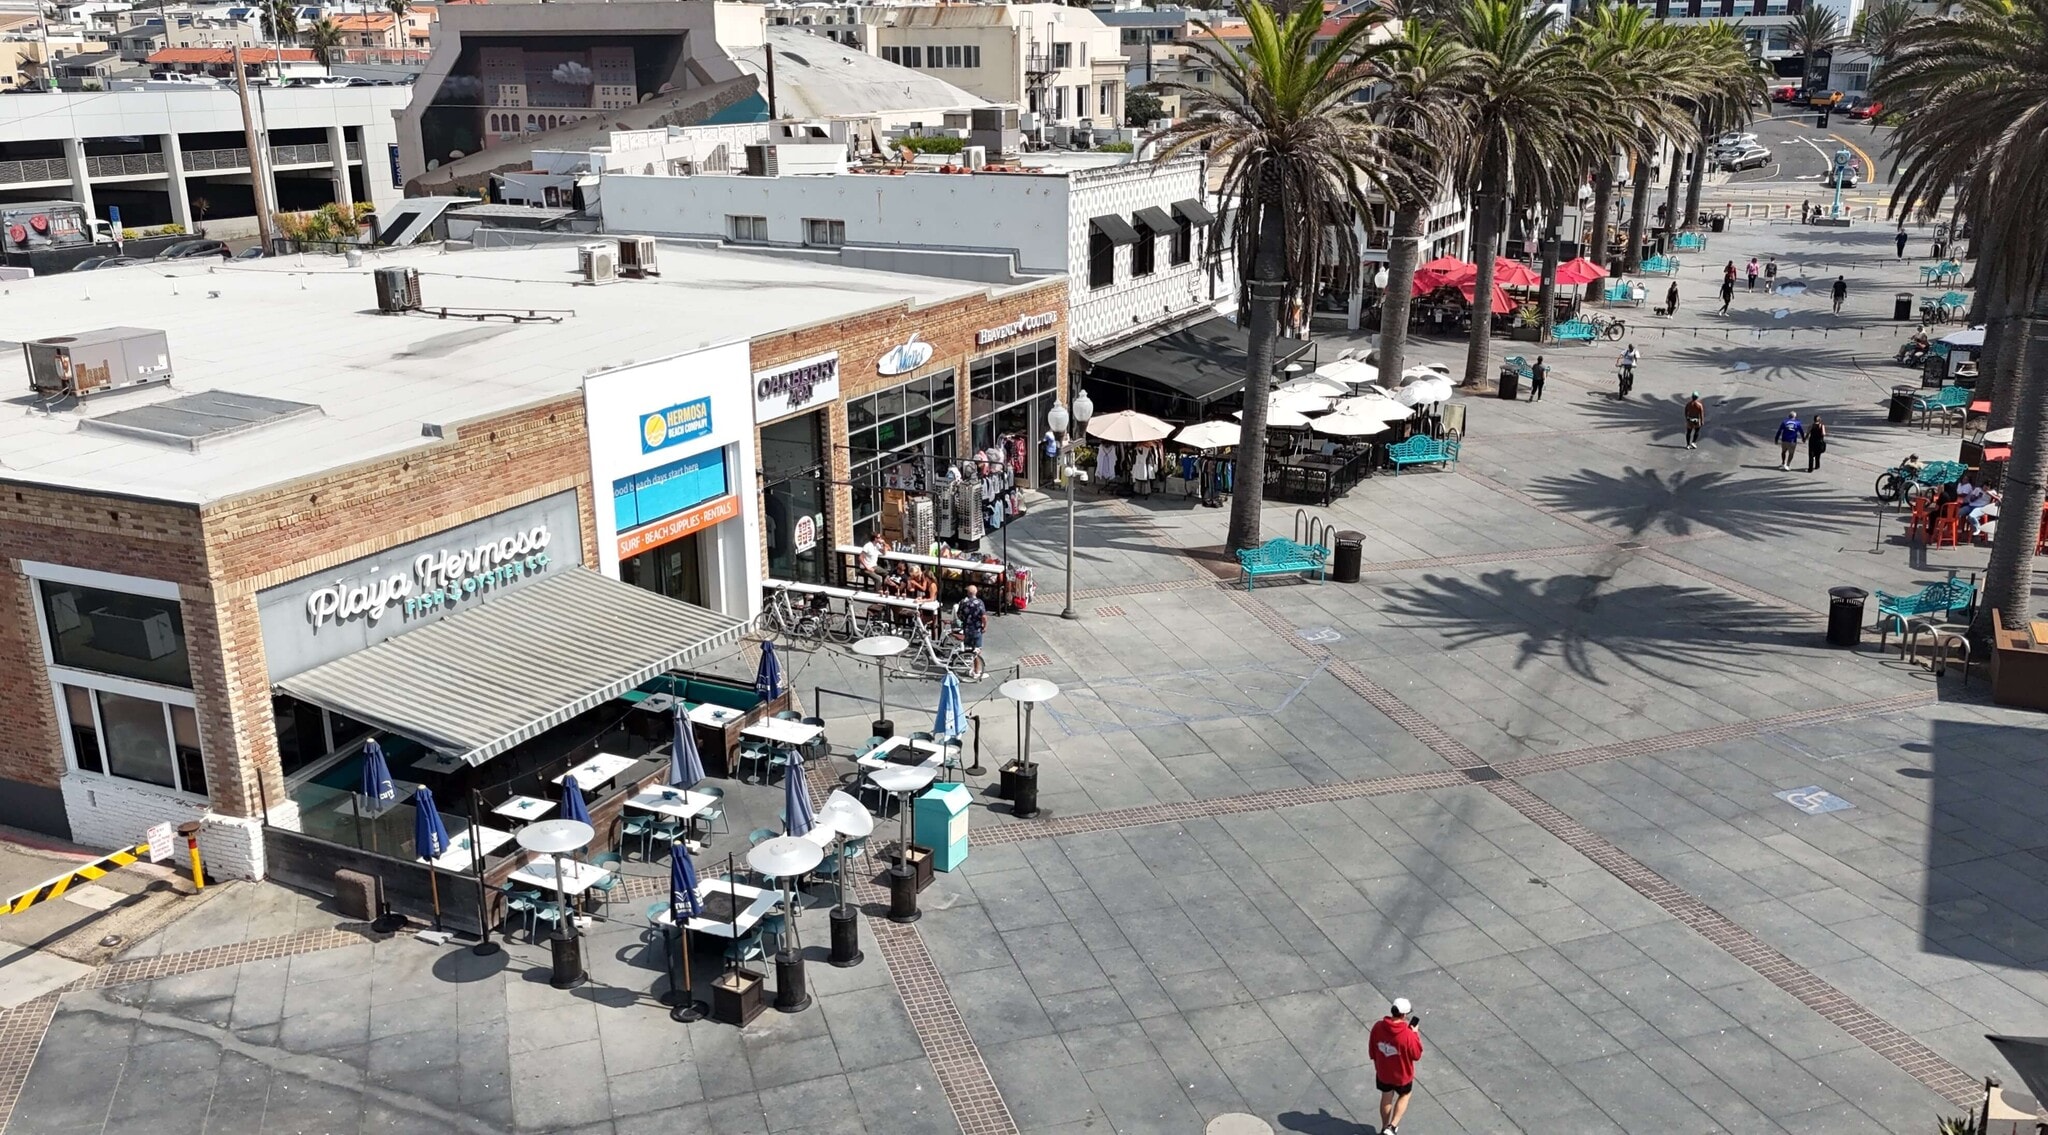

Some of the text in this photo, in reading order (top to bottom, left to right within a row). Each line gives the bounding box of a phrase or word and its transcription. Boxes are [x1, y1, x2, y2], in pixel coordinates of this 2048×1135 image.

[978, 311, 1058, 345] HEAVENLY COUTURE
[758, 358, 837, 399] OAKBERRY
[667, 401, 707, 428] HERMOSA
[668, 417, 708, 439] BEACH COMPANY
[614, 485, 629, 497] ood
[652, 473, 668, 485] days
[668, 468, 684, 480] start
[684, 462, 699, 474] here
[620, 502, 732, 554] SURF BEACH SUPPLIES RENTALS
[308, 525, 551, 627] Playa Hermosa
[405, 588, 445, 615] FISH
[462, 560, 524, 592] OYSTER
